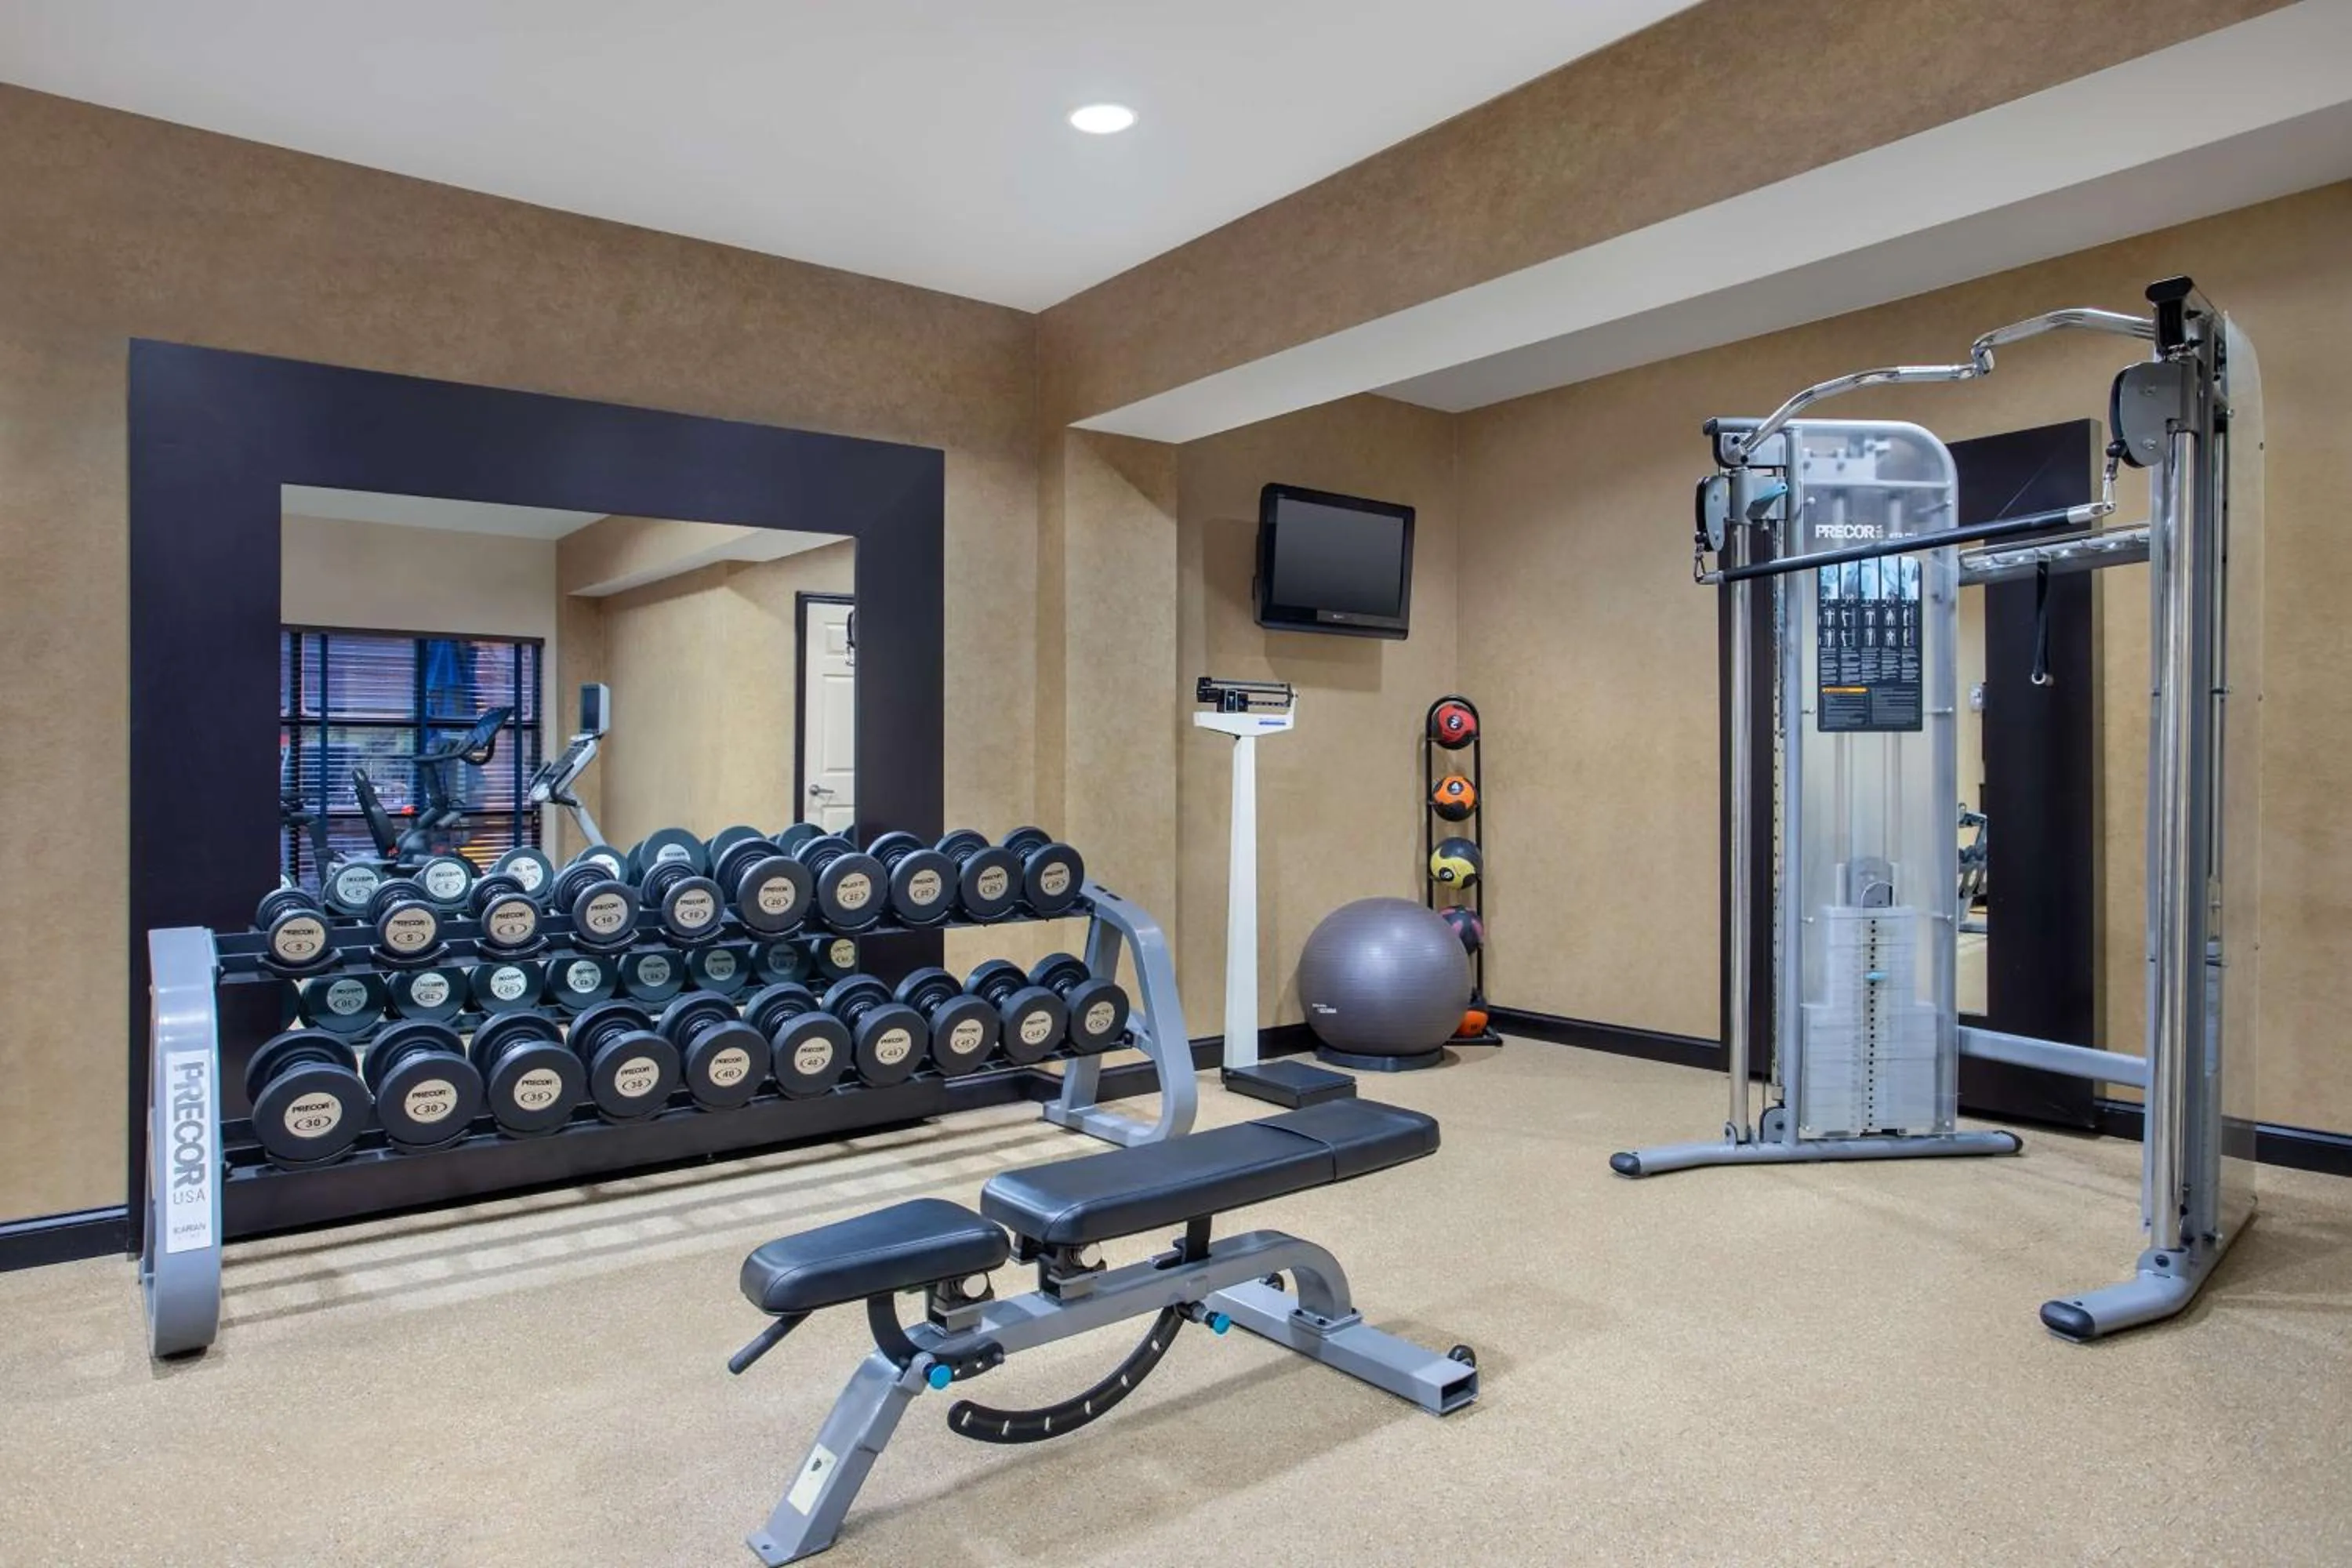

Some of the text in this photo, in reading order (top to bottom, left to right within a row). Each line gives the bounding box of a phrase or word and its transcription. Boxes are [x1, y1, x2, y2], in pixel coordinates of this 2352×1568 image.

[1815, 524, 1875, 539] PRECOR
[1450, 714, 1460, 729] 2
[1451, 782, 1460, 793] 4
[590, 902, 619, 911] PRECOR
[714, 1056, 742, 1065] PRECOR
[620, 1066, 650, 1076] PRECOR
[412, 1090, 446, 1098] PRECOR
[292, 1102, 329, 1113] PRECOR
[173, 1062, 207, 1189] PRECOR
[172, 1189, 206, 1204] USA
